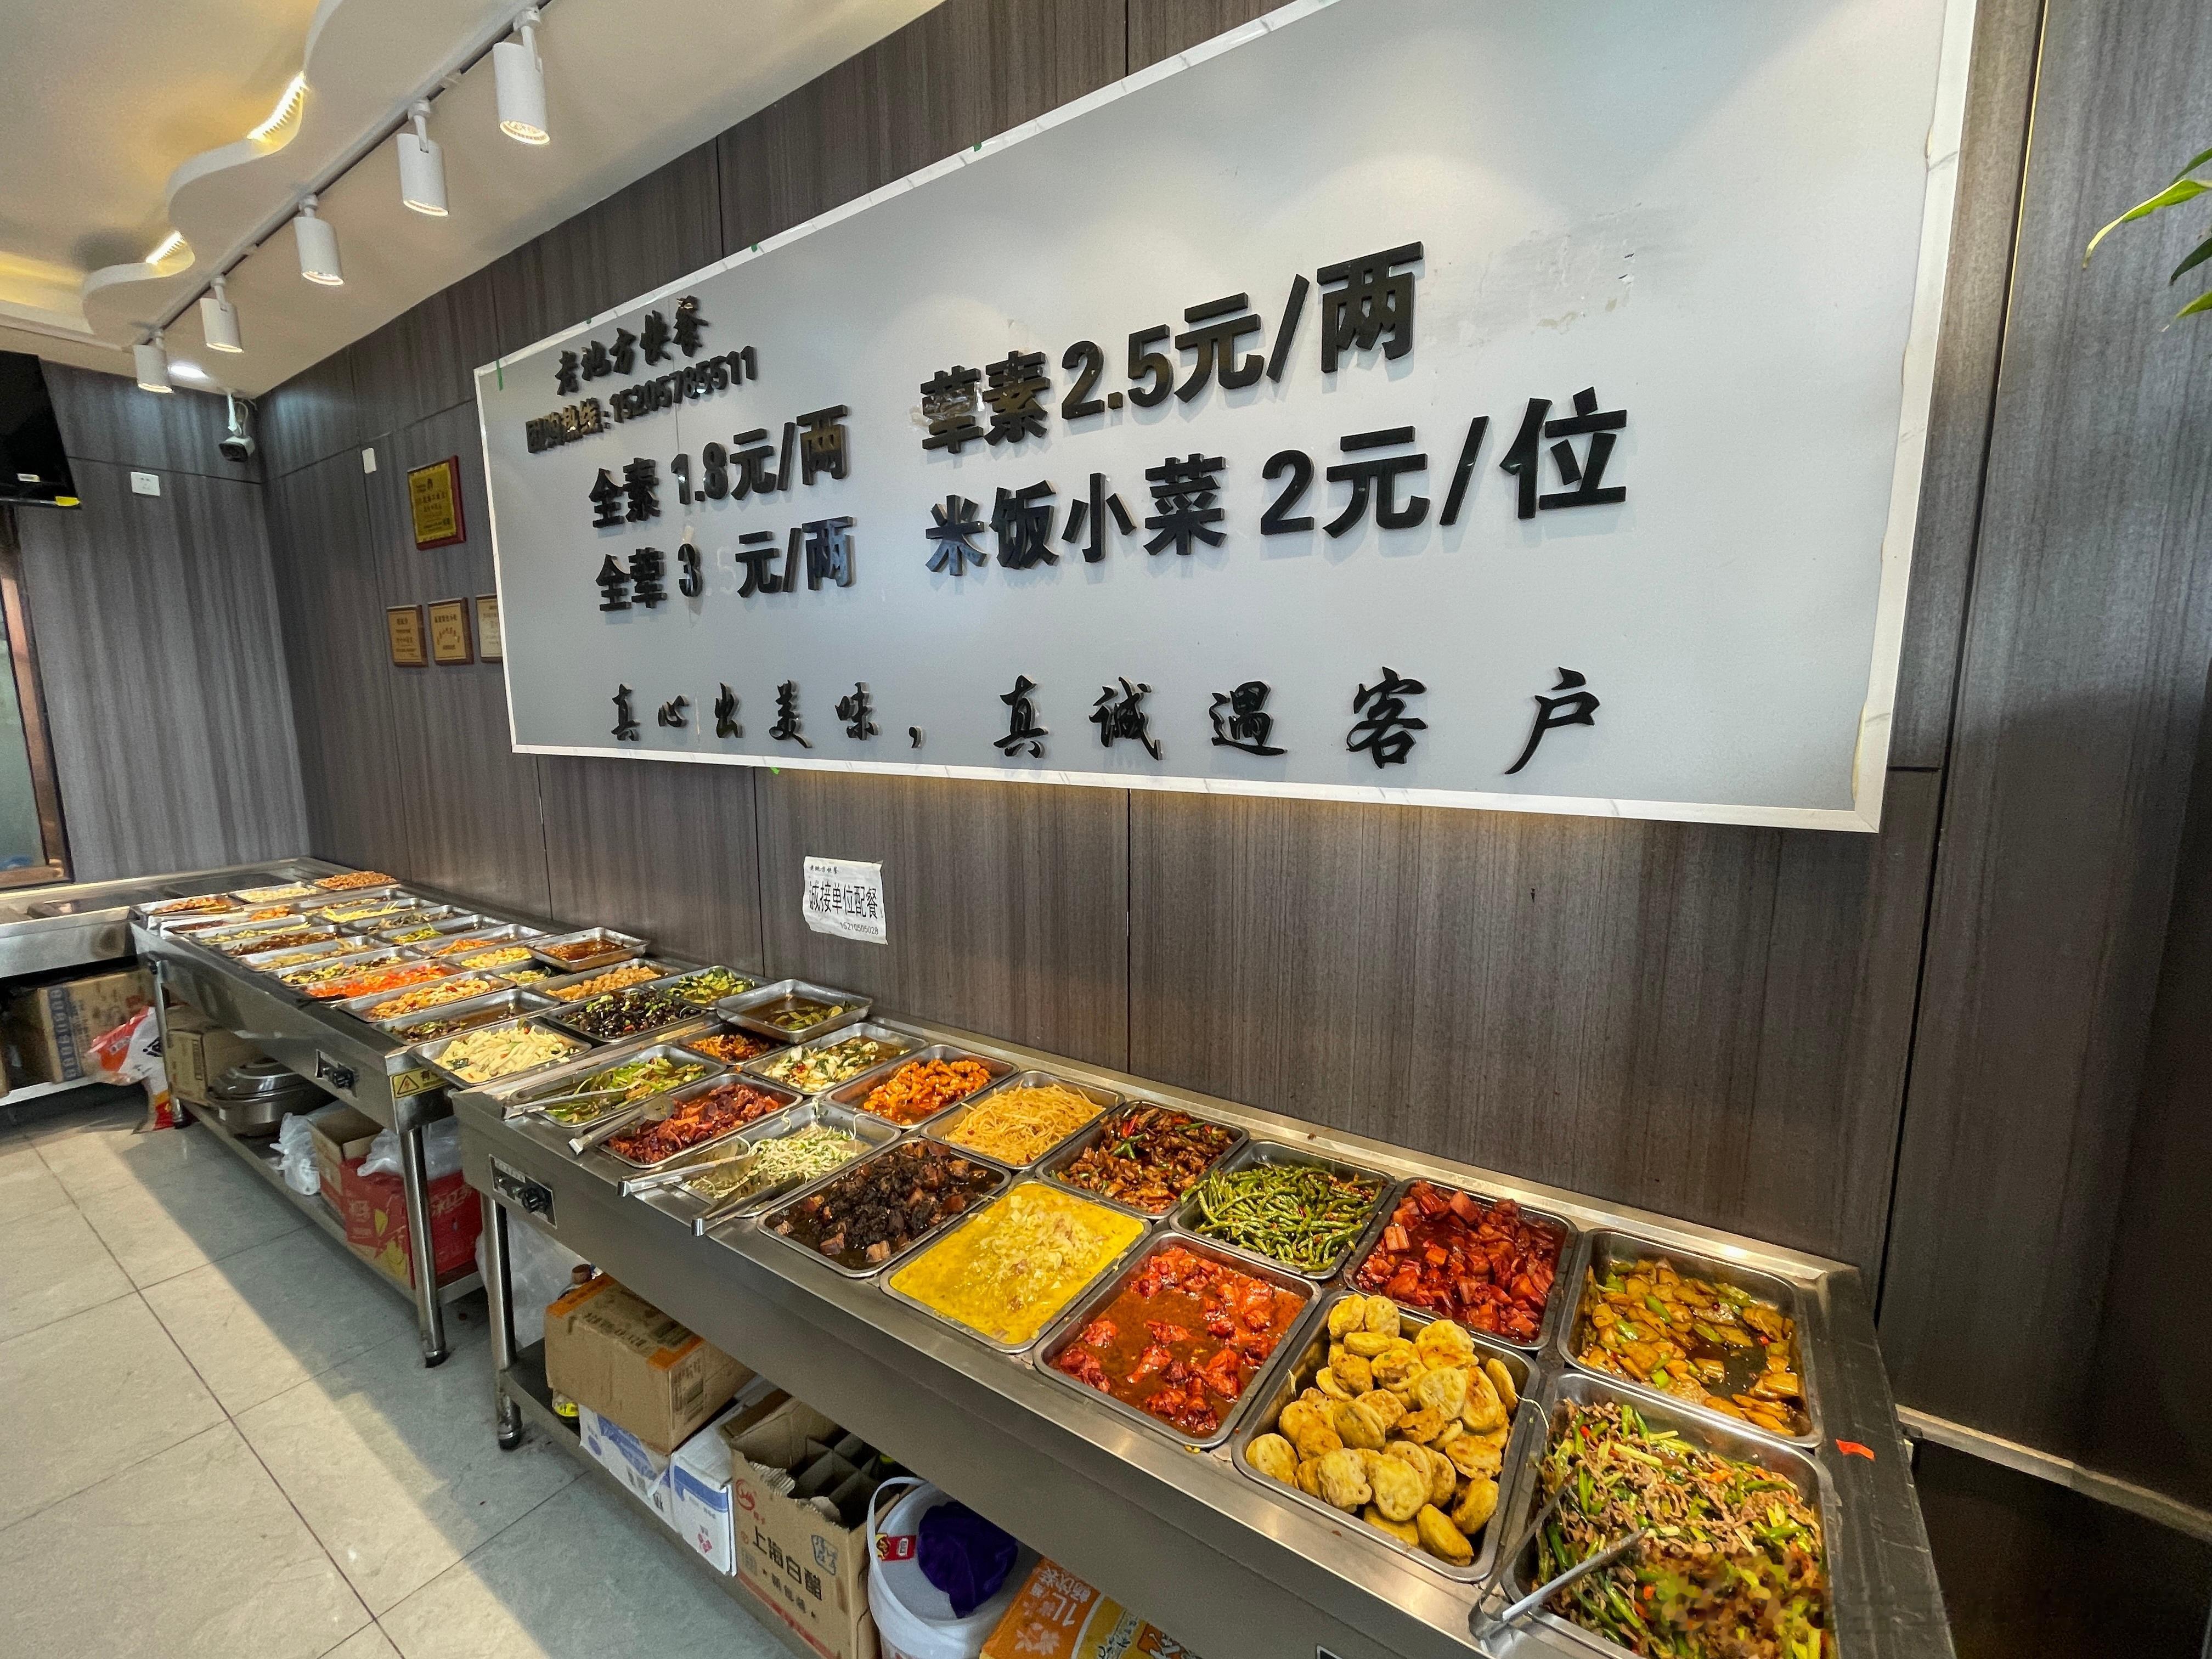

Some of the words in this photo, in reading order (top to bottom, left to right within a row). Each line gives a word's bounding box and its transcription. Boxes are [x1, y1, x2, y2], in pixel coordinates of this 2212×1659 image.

[925, 453, 1228, 577] 米饭小菜
[1260, 386, 1628, 539] 2元/位
